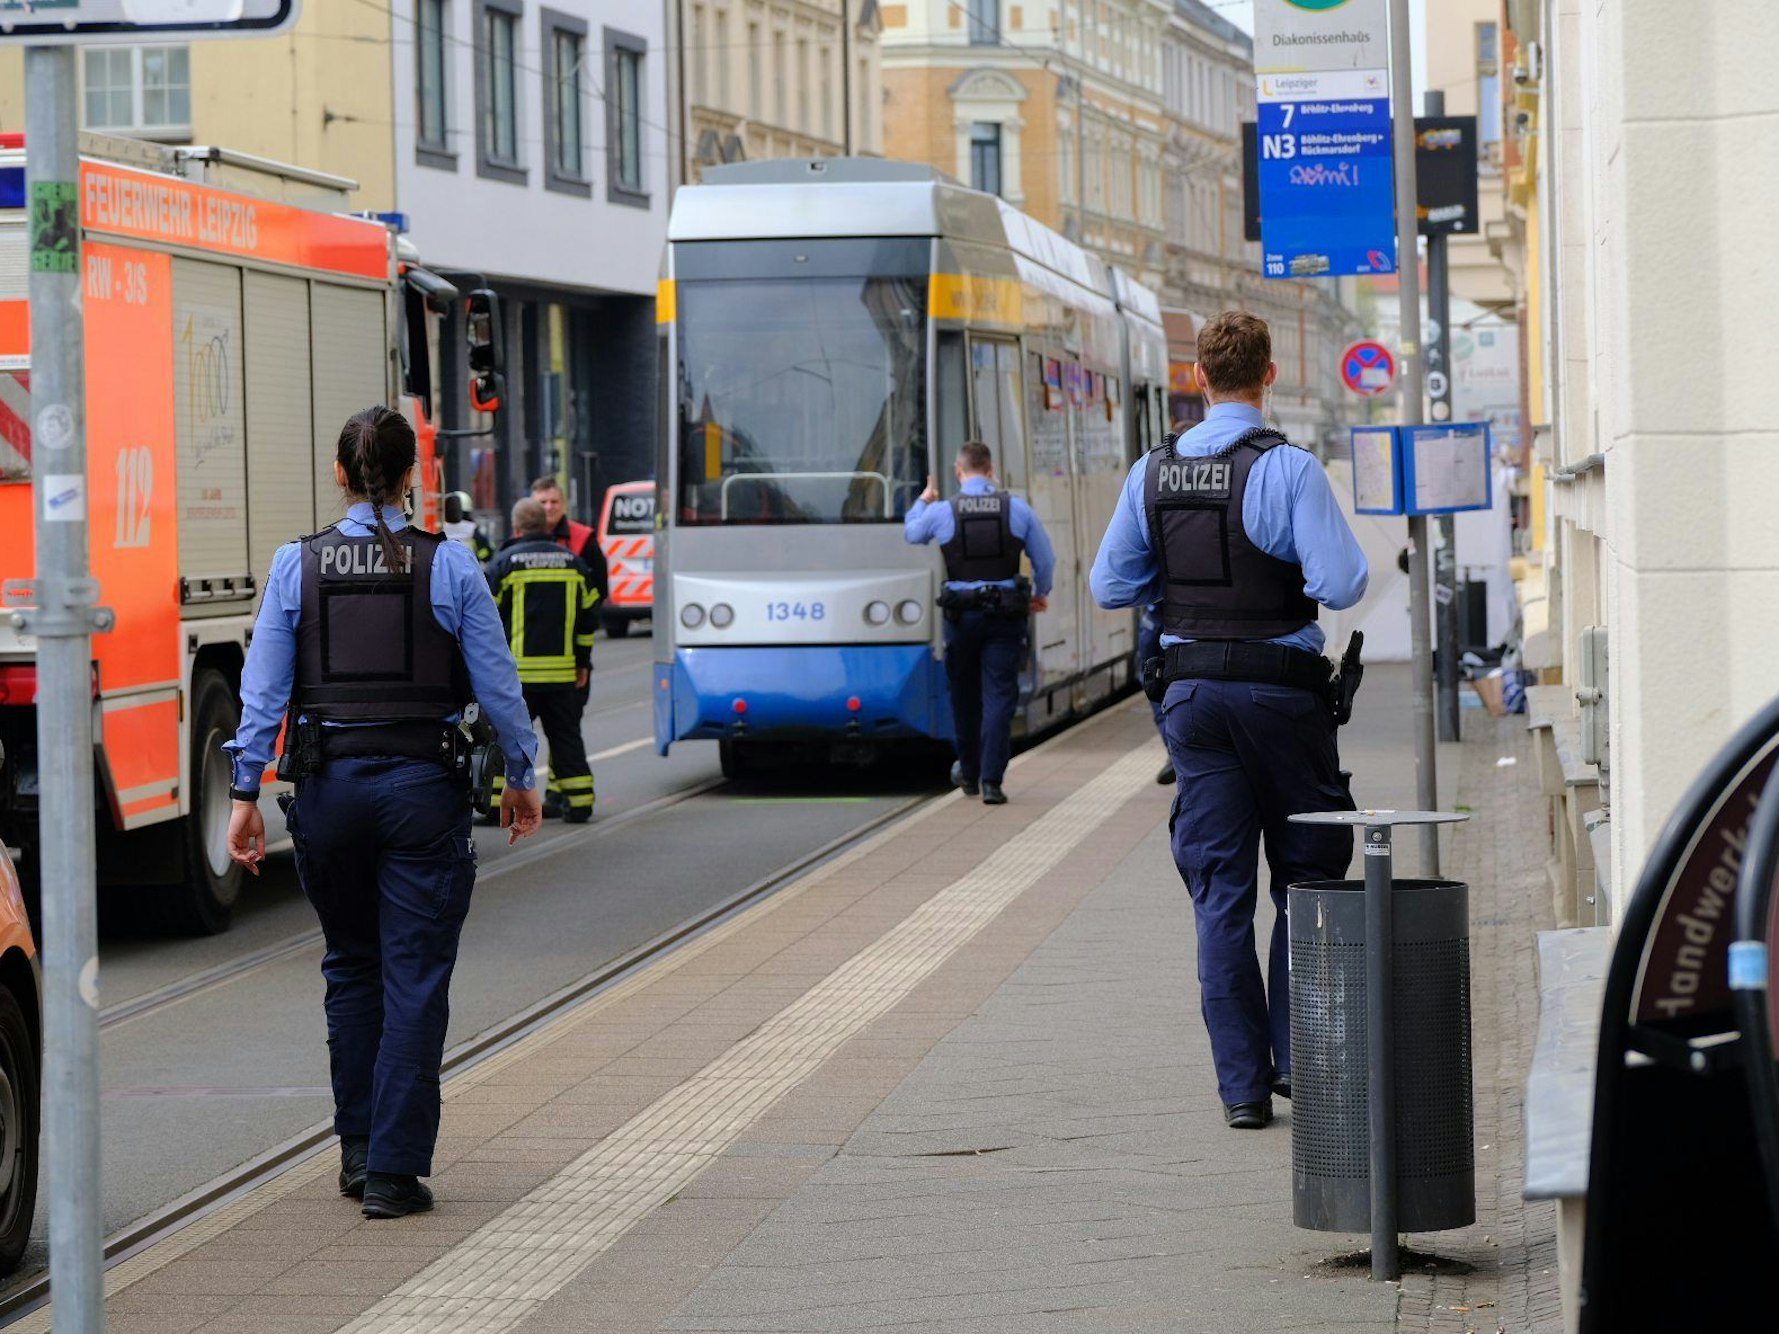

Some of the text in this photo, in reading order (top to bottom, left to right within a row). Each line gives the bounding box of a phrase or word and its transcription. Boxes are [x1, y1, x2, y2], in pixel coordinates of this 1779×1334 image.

[1275, 77, 1318, 89] Leipziger
[1280, 104, 1295, 128] 7
[1262, 133, 1296, 159] N3
[85, 172, 258, 249] FEUERWEHR LEIPZIG
[87, 255, 112, 300] RW
[1266, 262, 1285, 275] 110
[1158, 463, 1230, 492] POLIZEI
[113, 446, 153, 548] 112
[959, 498, 1001, 512] POLIZEI
[320, 543, 413, 575] POLIZI
[767, 602, 825, 621] 1348
